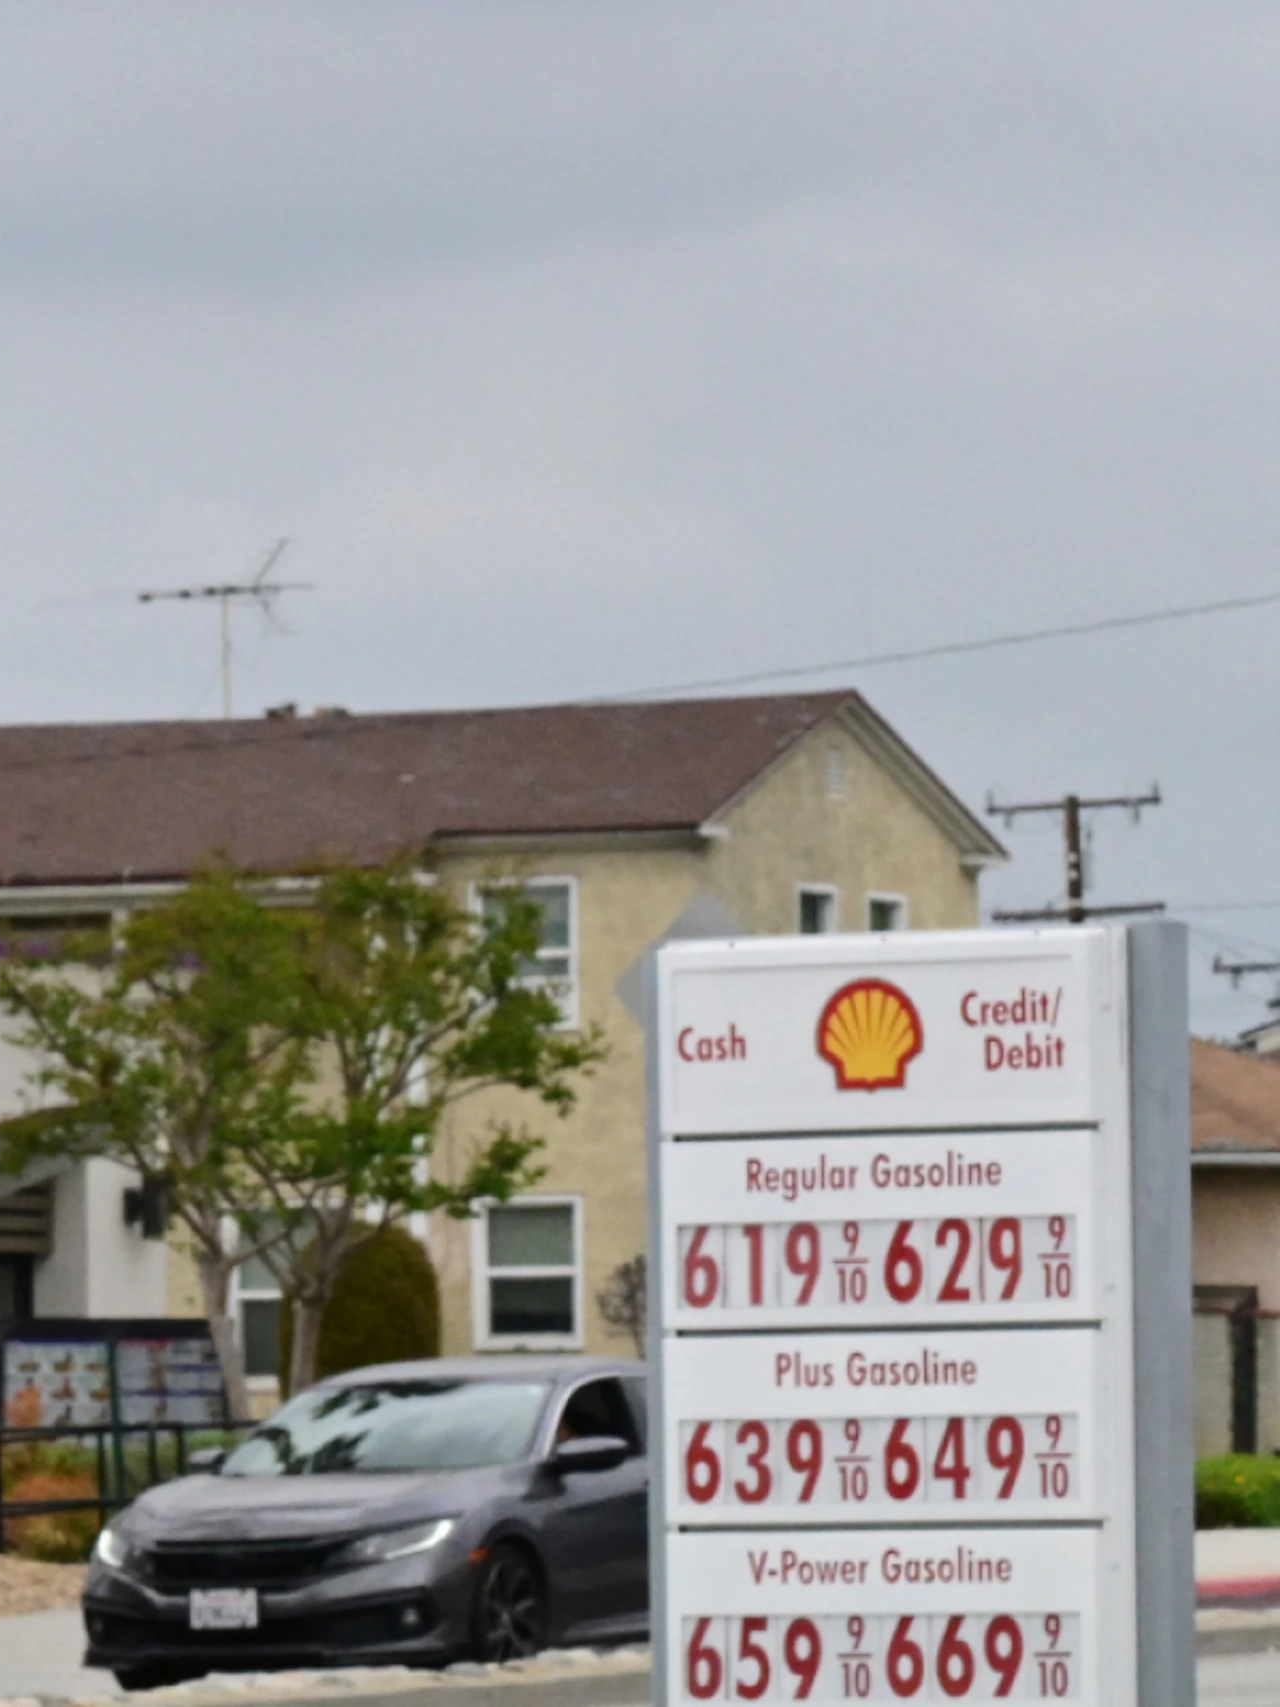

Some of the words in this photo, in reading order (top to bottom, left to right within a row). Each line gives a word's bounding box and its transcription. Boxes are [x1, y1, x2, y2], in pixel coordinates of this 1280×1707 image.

[960, 987, 1062, 1026] Credit/
[677, 1023, 746, 1061] Cash
[984, 1034, 1064, 1070] Debit
[746, 1154, 857, 1201] Regular
[870, 1153, 1002, 1188] Gasoline
[683, 1223, 821, 1308] 619
[883, 1217, 1023, 1304] 629
[774, 1352, 835, 1388] Plus
[846, 1350, 978, 1386] Gasoline
[684, 1419, 823, 1504] 639
[883, 1416, 1024, 1500] 649
[747, 1550, 867, 1585] V-Power
[881, 1547, 1011, 1584] Gasoline
[686, 1616, 823, 1700] 659
[885, 1614, 1024, 1698] 669
